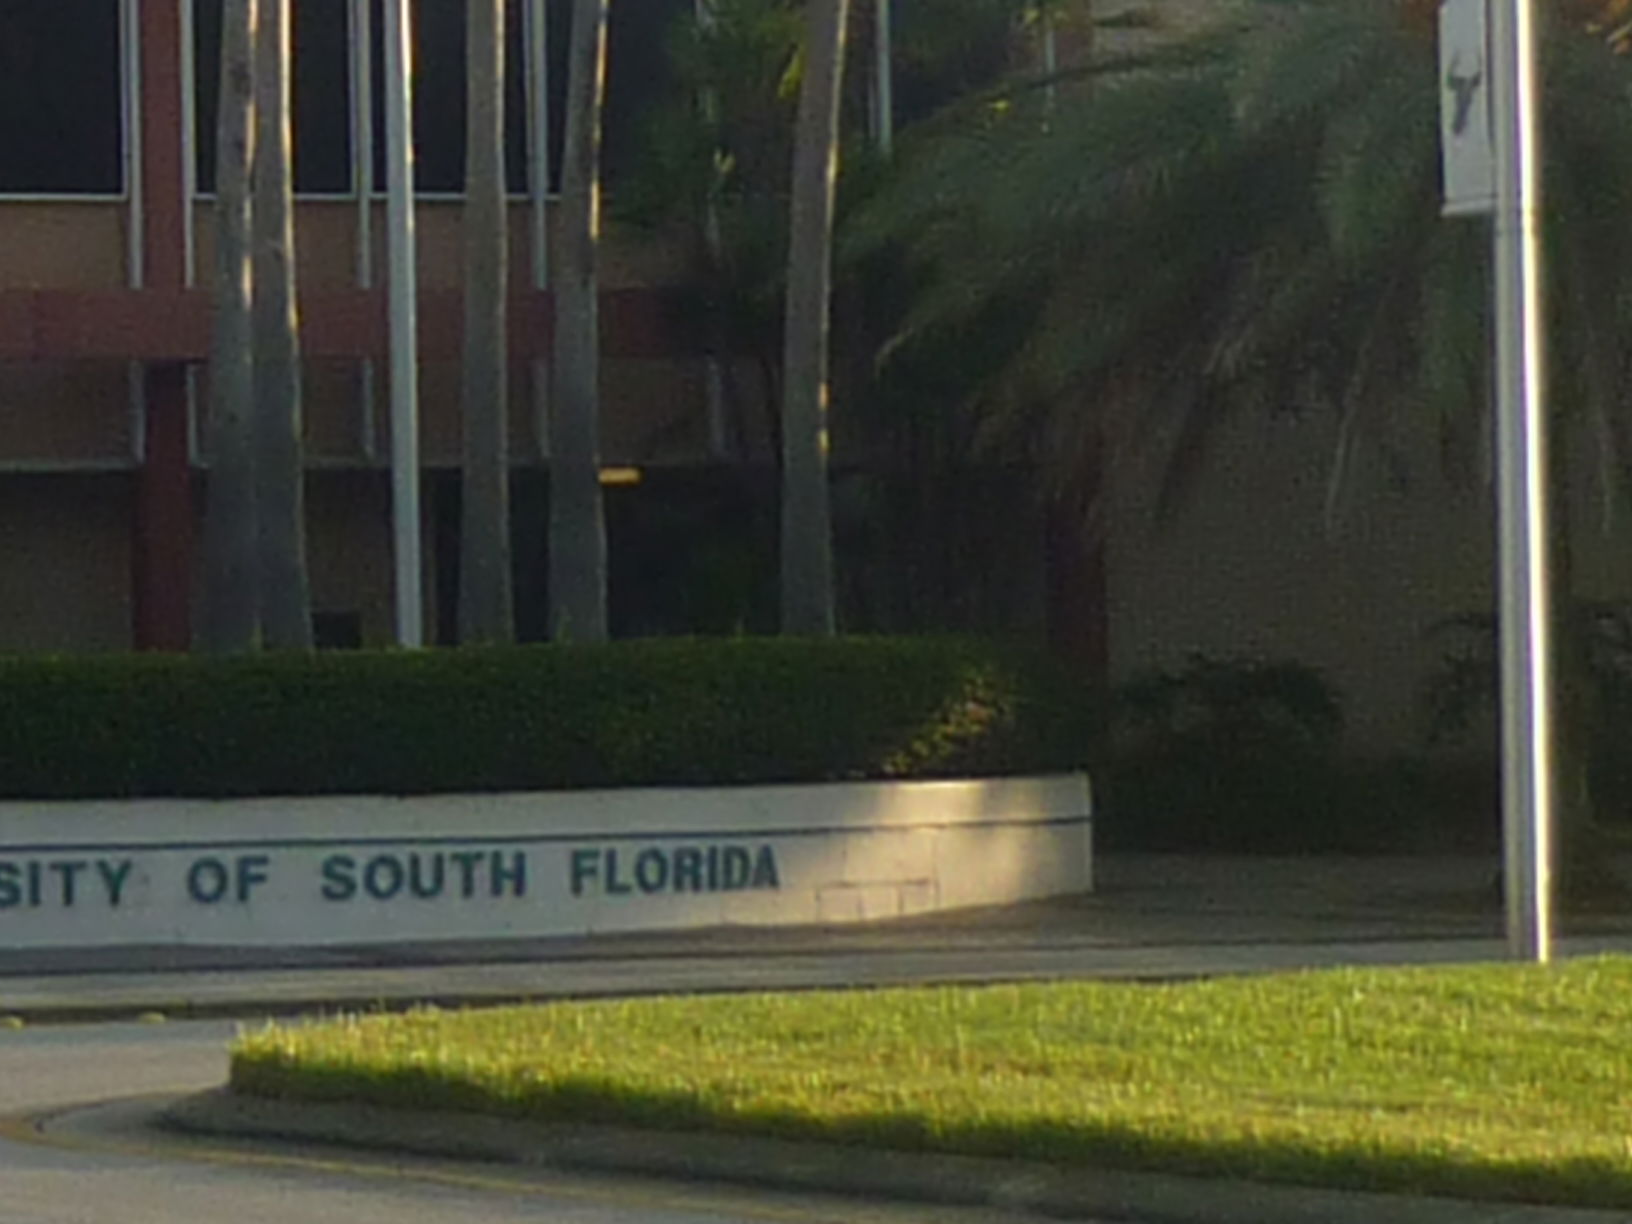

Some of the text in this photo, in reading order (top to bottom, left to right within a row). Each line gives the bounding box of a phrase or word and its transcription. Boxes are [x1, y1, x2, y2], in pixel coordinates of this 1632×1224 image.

[187, 856, 270, 903] OF
[321, 850, 526, 901] SOUTH
[571, 844, 780, 898] FLORIDA
